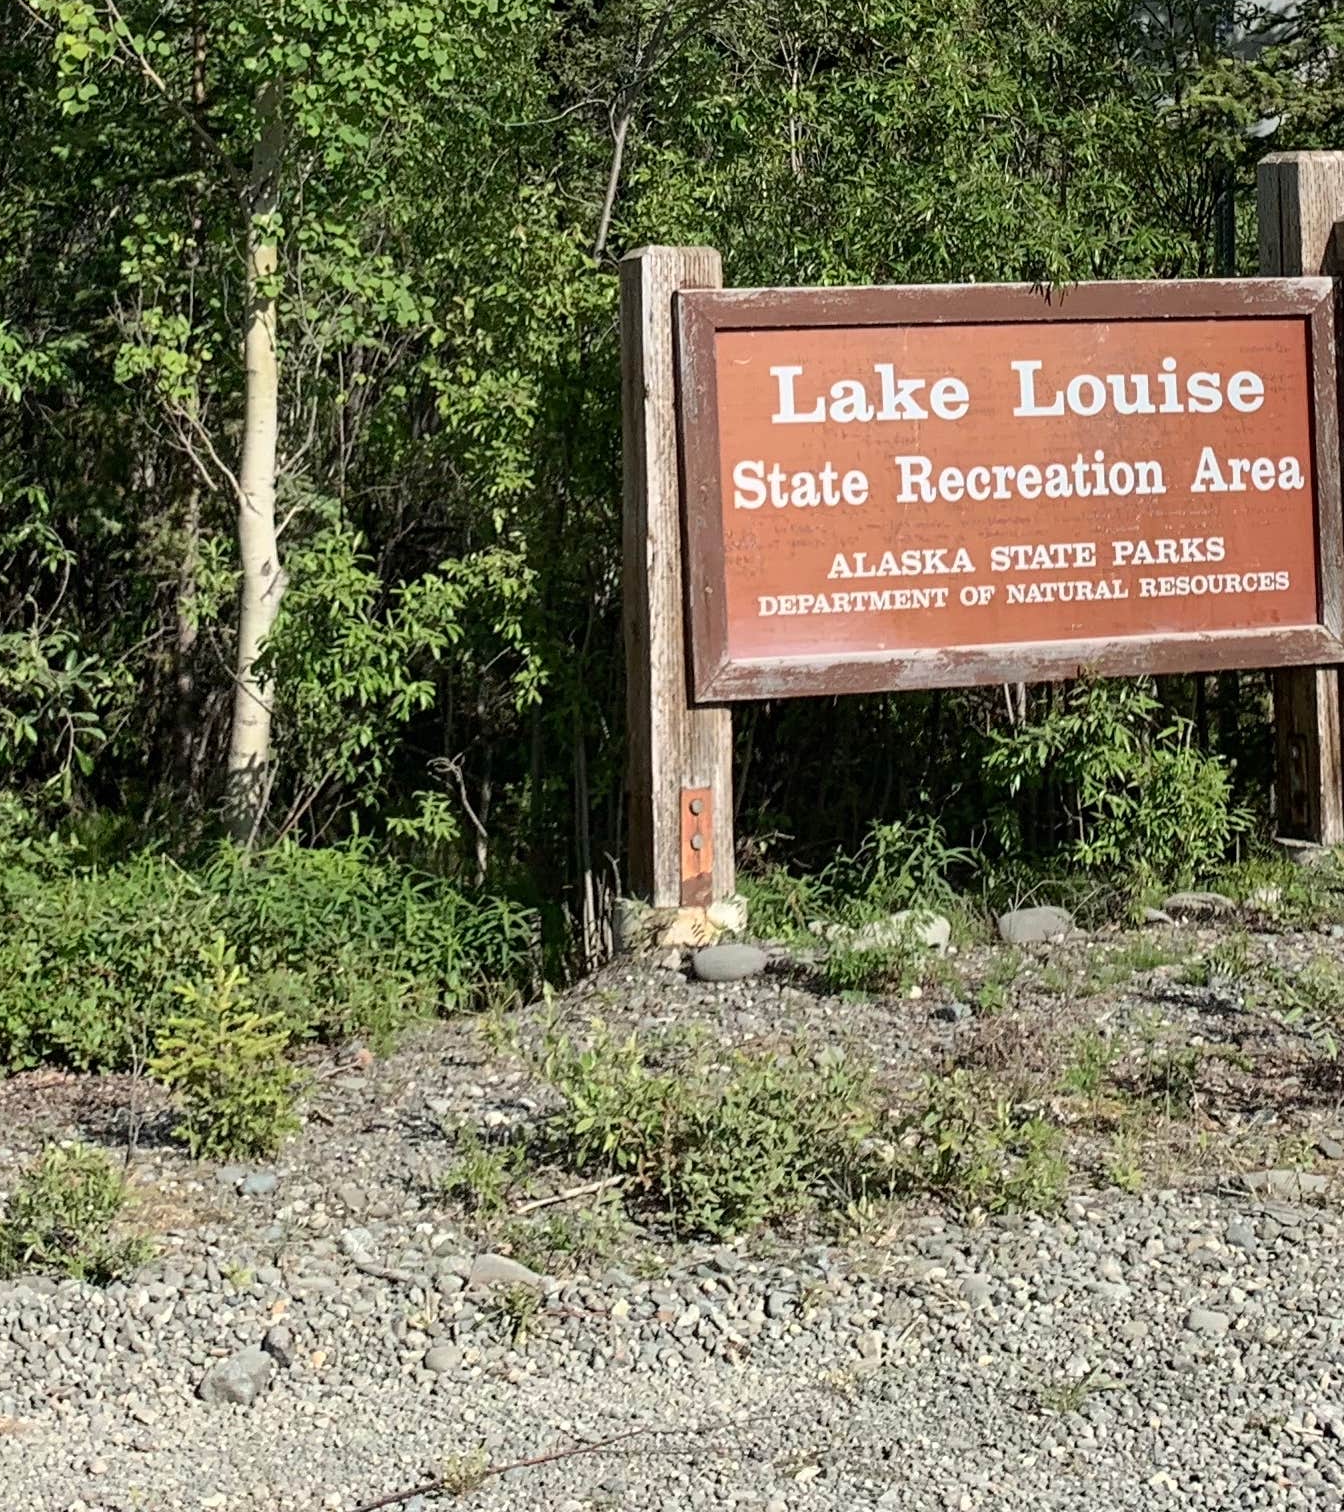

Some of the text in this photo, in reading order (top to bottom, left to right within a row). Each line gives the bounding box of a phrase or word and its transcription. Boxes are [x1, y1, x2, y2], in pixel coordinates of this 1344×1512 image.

[769, 356, 1265, 424] Lake Louise
[733, 446, 1305, 509] State Recreation Area
[827, 536, 1225, 579] ALASKA STATE PARKS
[758, 571, 1290, 616] DEPARTMENT OF NATURAL RESOURCES
